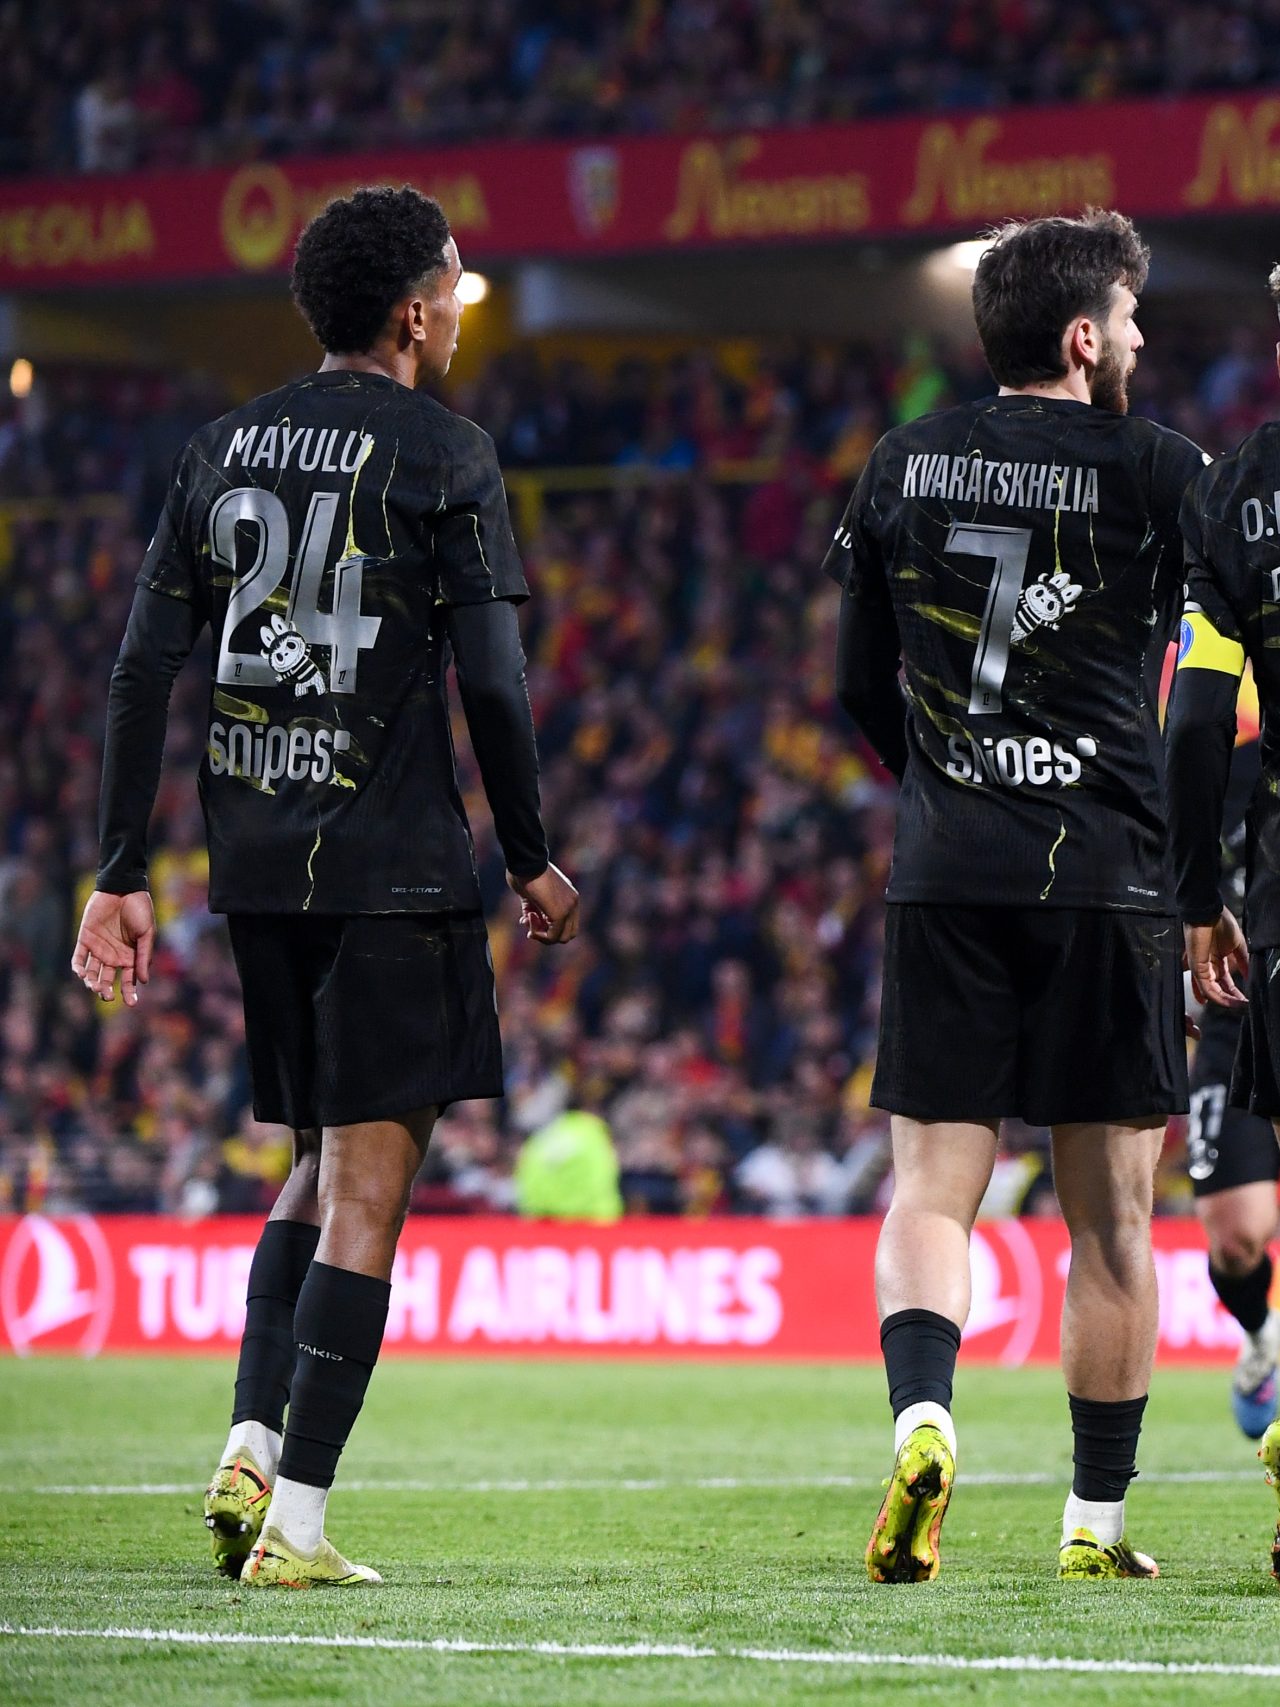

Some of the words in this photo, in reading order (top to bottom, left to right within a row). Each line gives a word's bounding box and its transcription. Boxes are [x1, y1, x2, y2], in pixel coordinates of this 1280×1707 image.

[0, 200, 156, 269] EOLIA
[223, 425, 375, 474] MAYULU
[903, 453, 1099, 513] KVARATSKHELIA
[209, 487, 382, 694] 24
[944, 522, 1034, 715] 7
[209, 723, 335, 791] snipes
[449, 1246, 784, 1345] AIRLINES
